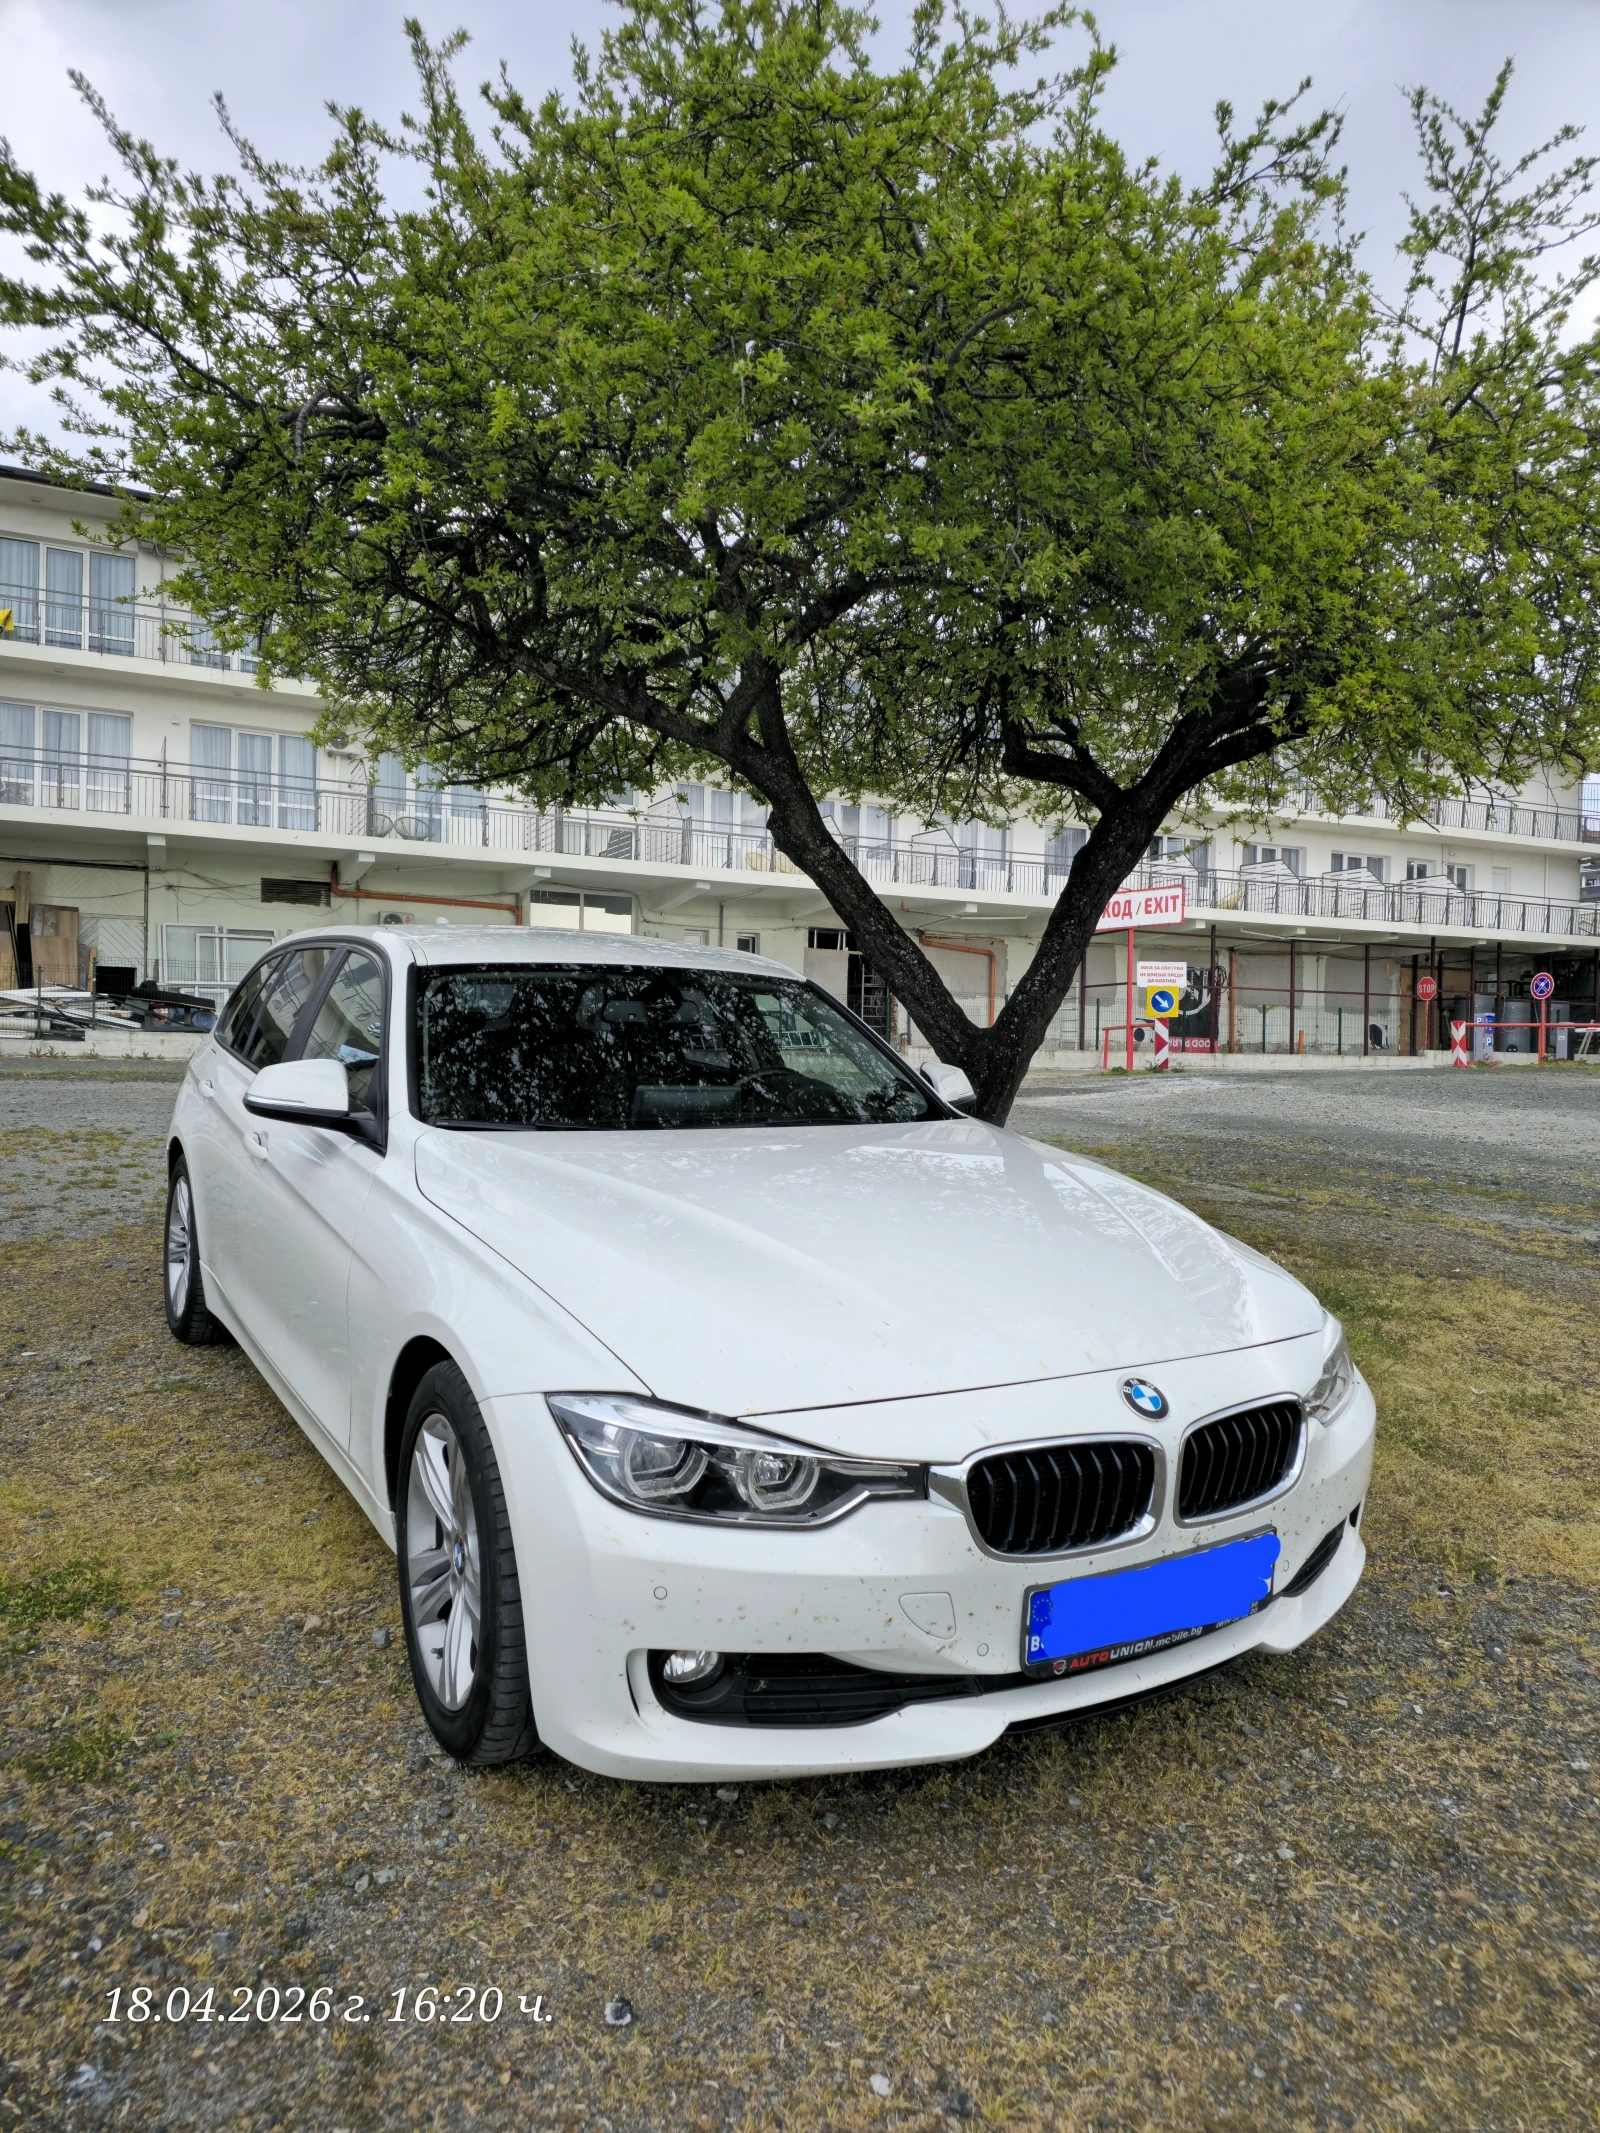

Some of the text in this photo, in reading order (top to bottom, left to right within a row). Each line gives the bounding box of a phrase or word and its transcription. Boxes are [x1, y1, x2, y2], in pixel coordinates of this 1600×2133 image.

[1102, 899, 1133, 920] ХОД
[1144, 894, 1179, 914] EXIT
[1418, 984, 1434, 993] STOP
[1486, 1037, 1492, 1046] P
[1123, 1378, 1155, 1394] BMW
